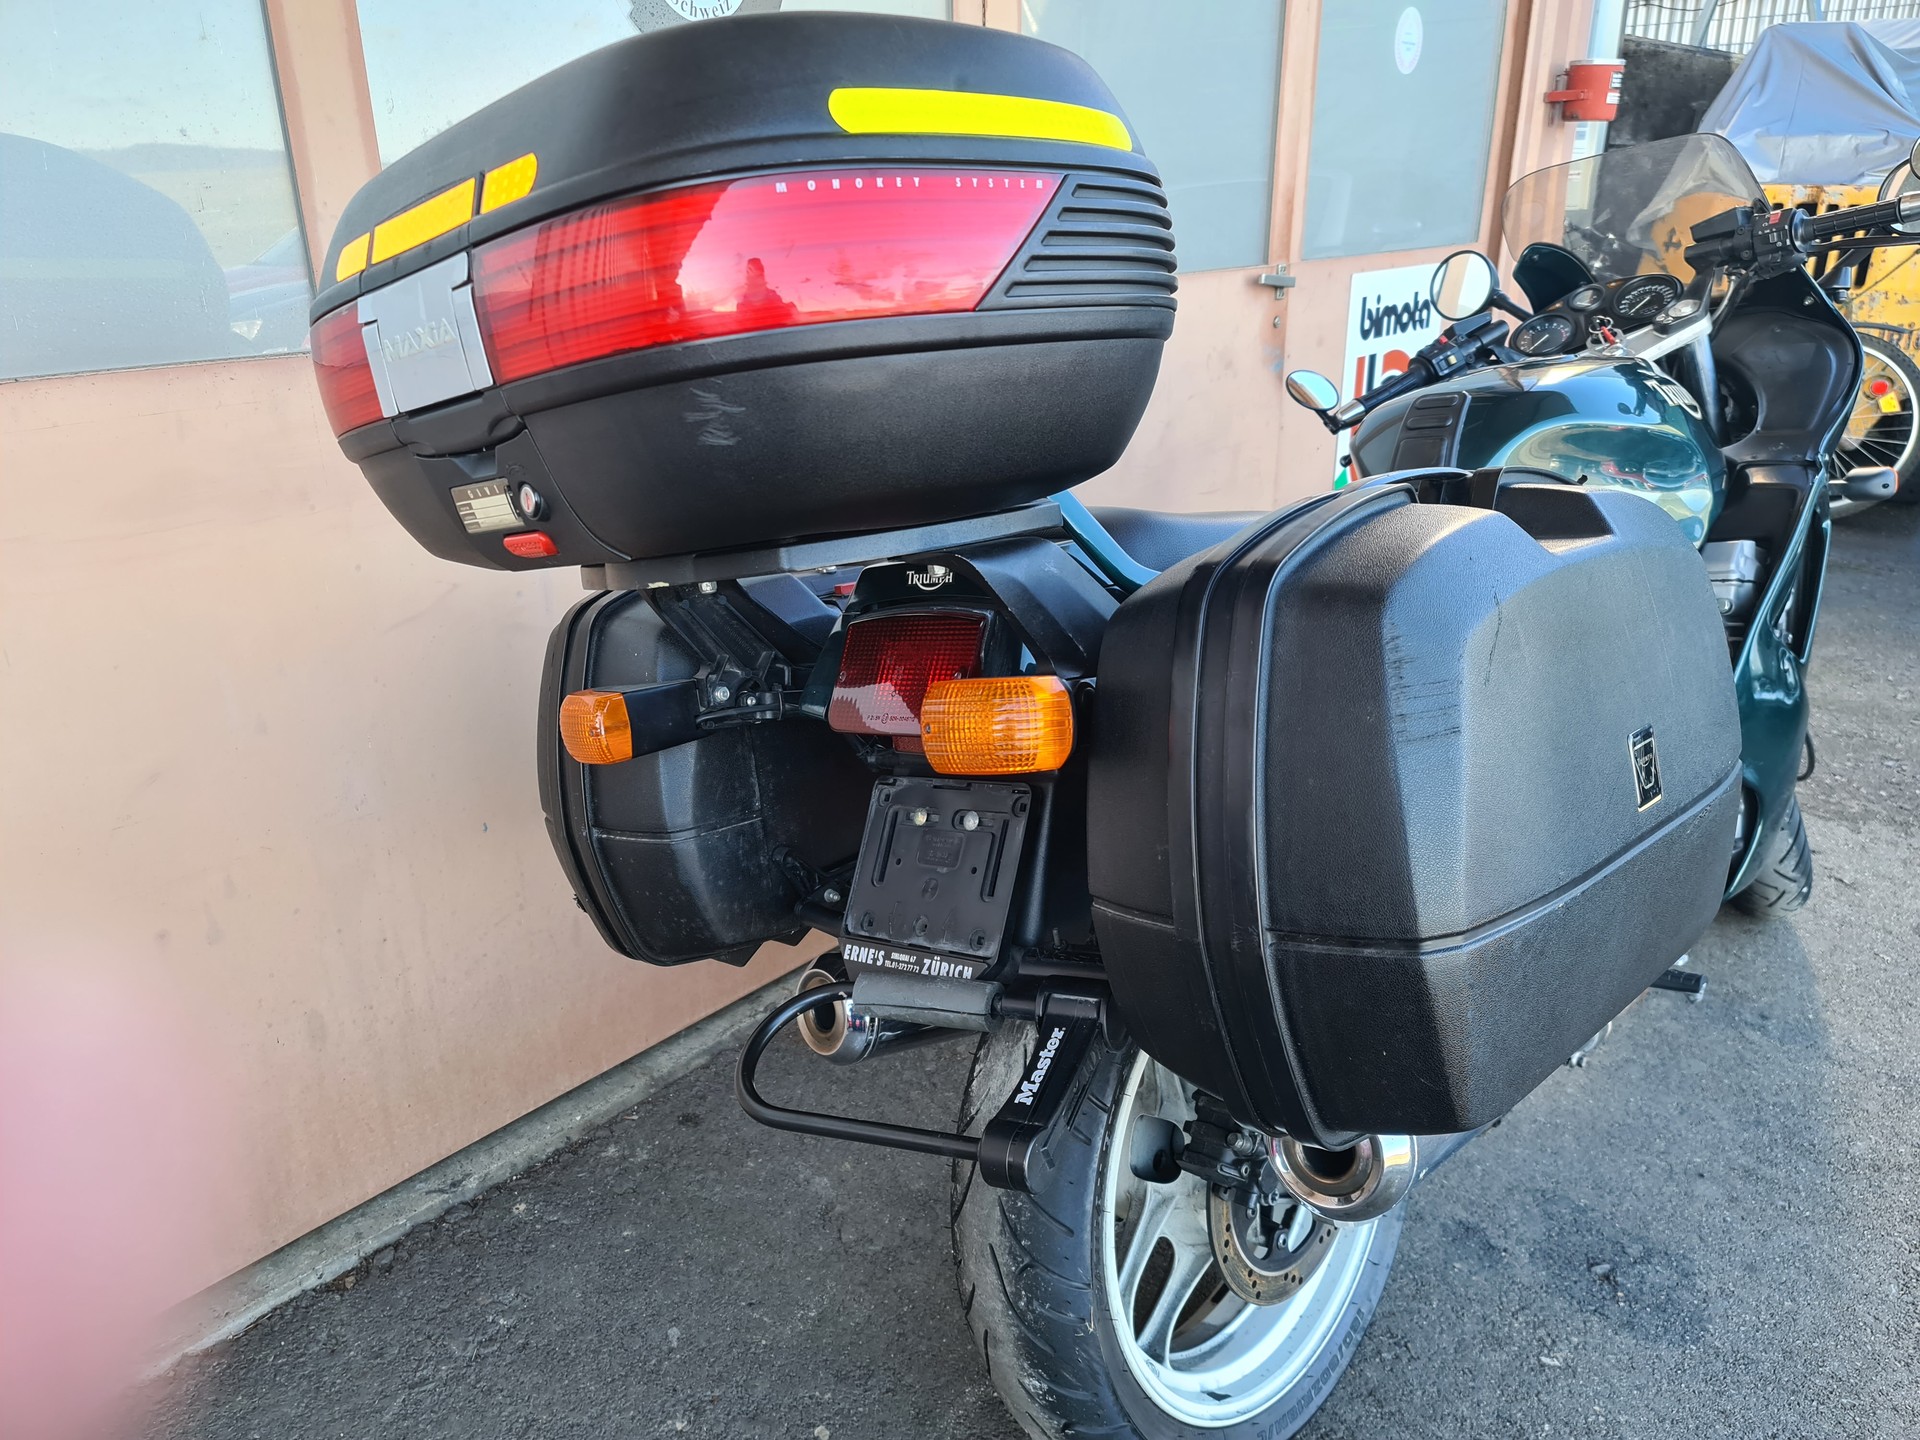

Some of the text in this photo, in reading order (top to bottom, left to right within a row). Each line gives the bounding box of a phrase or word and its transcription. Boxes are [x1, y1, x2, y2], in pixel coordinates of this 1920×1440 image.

[775, 177, 1043, 193] MONOKEY SYSTEM
[843, 944, 885, 966] ERNE'S
[921, 956, 973, 979] ZÜRICH
[1014, 1027, 1065, 1106] Master
